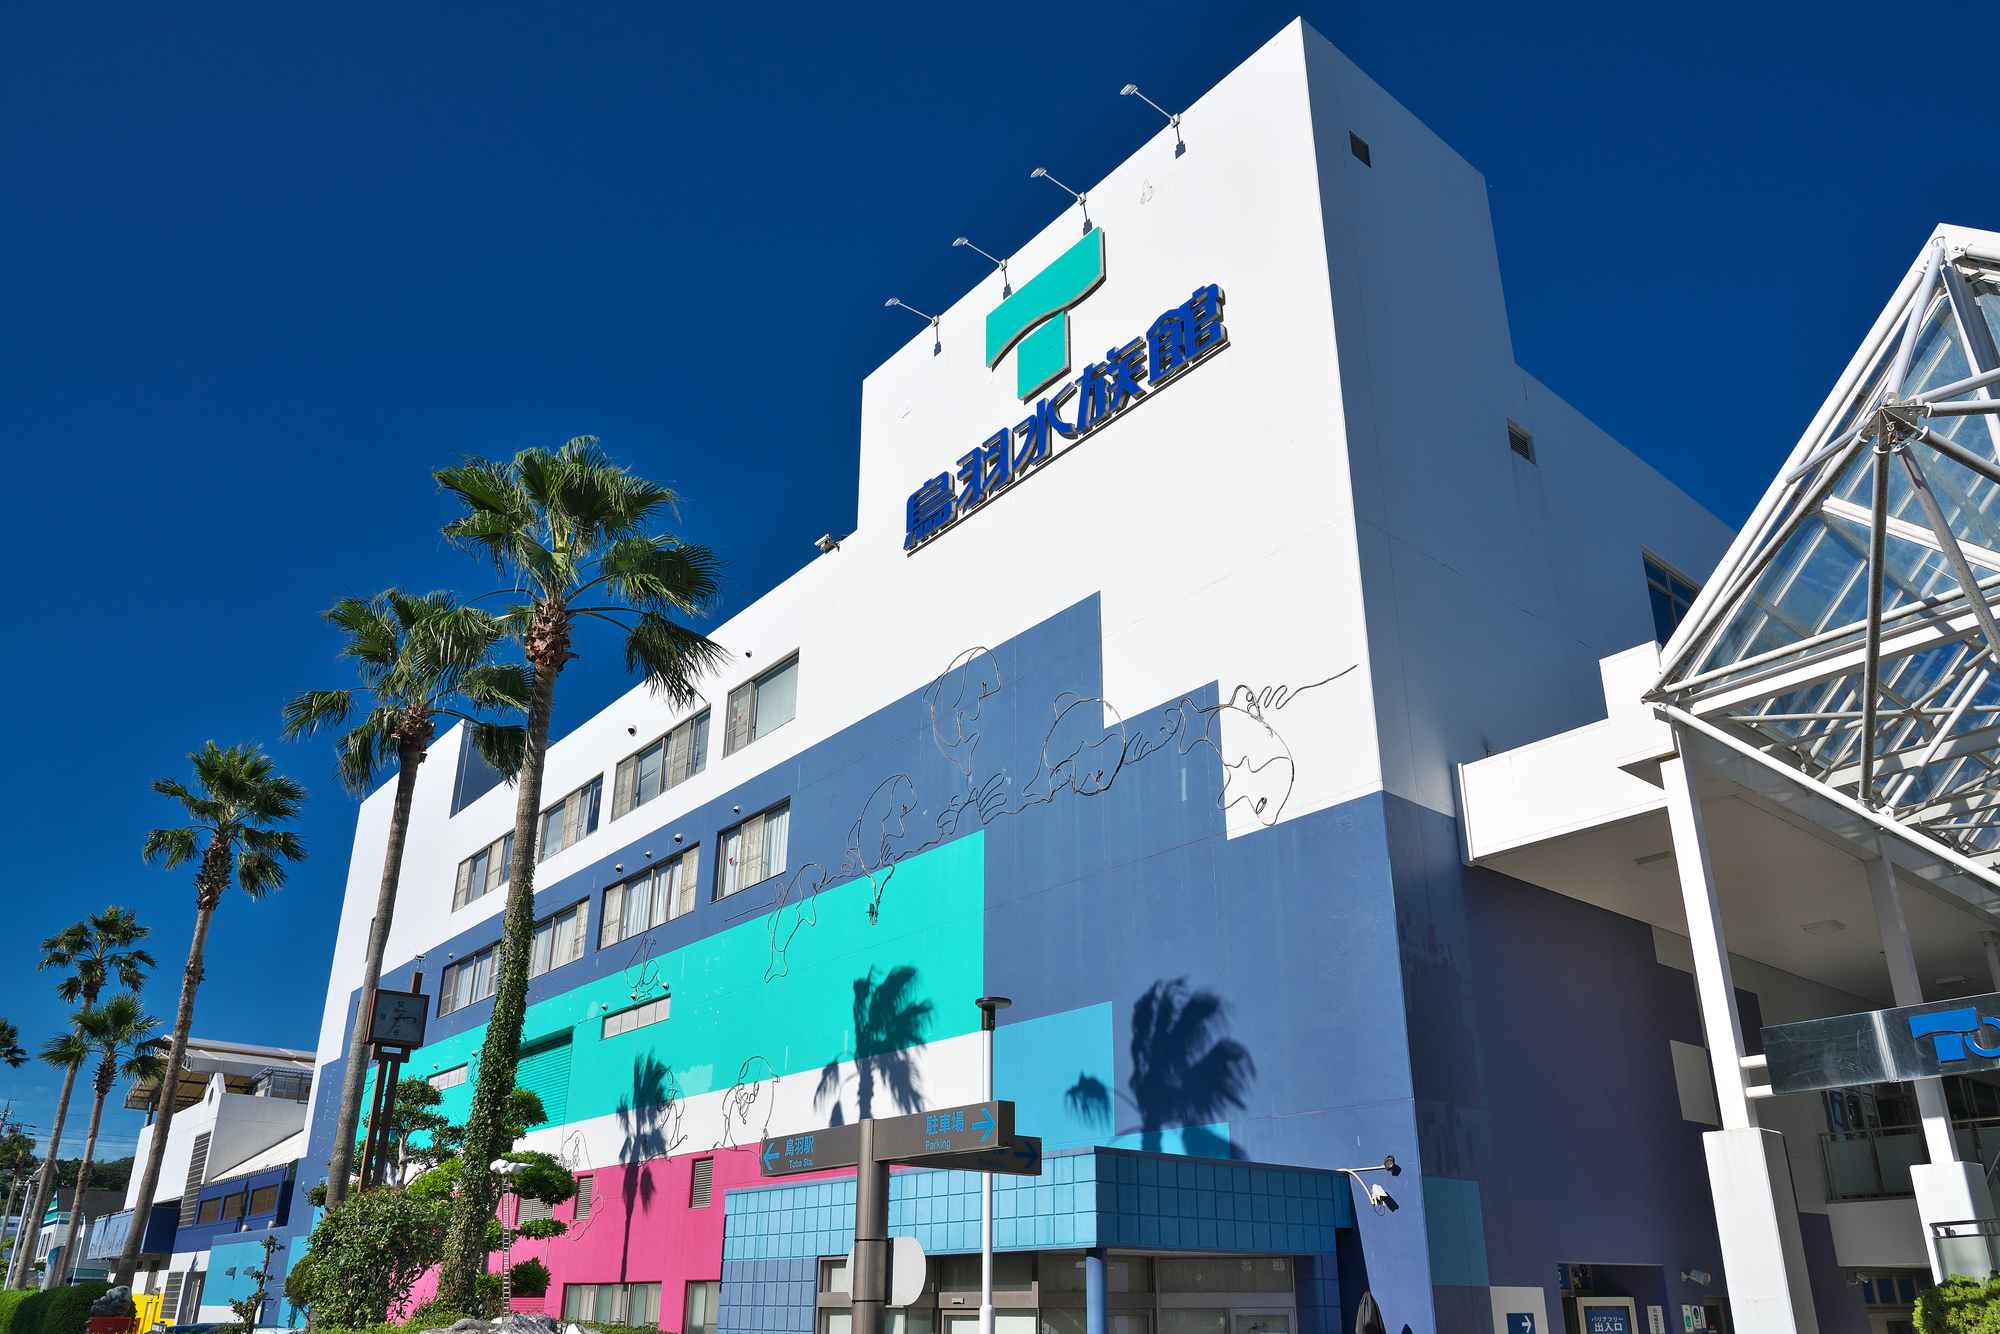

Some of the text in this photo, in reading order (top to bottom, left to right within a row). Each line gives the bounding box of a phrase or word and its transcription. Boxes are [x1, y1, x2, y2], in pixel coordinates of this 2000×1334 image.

[903, 283, 1226, 551] 鳥羽水族館
[411, 1016, 417, 1024] 3
[925, 1110, 965, 1136] 駐車場
[784, 1135, 815, 1157] 鳥羽駅
[925, 1138, 951, 1151] Parking
[788, 1157, 814, 1169] Toba Sta.
[978, 1157, 1006, 1169] Tickets
[1594, 1322, 1623, 1332] 出入口
